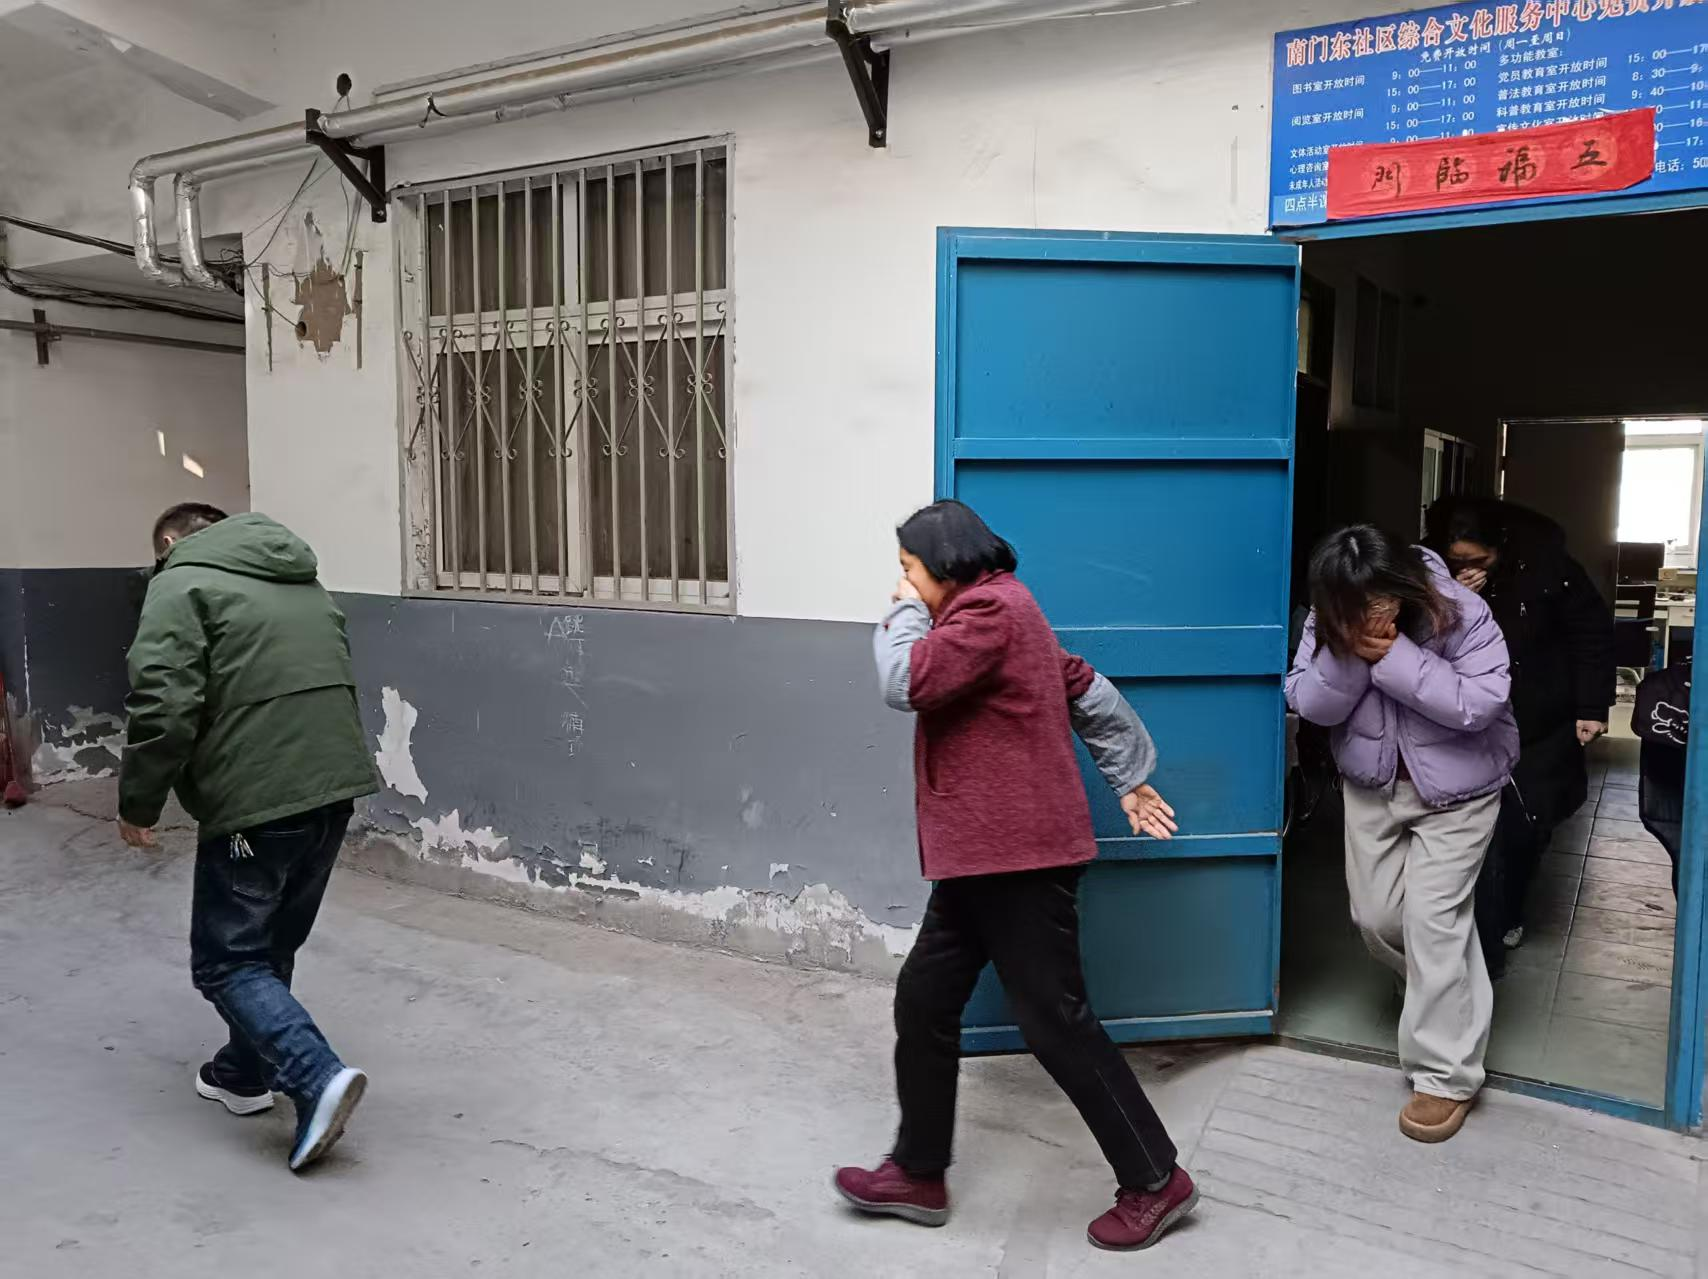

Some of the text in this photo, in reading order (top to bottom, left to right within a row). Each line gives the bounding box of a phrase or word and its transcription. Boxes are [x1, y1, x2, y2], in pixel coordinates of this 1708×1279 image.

[1286, 0, 1706, 67] 南门东社区综合文化服务中心免
[1292, 75, 1365, 94] 图书室开放时间
[1291, 107, 1364, 127] 阅览室开放时间
